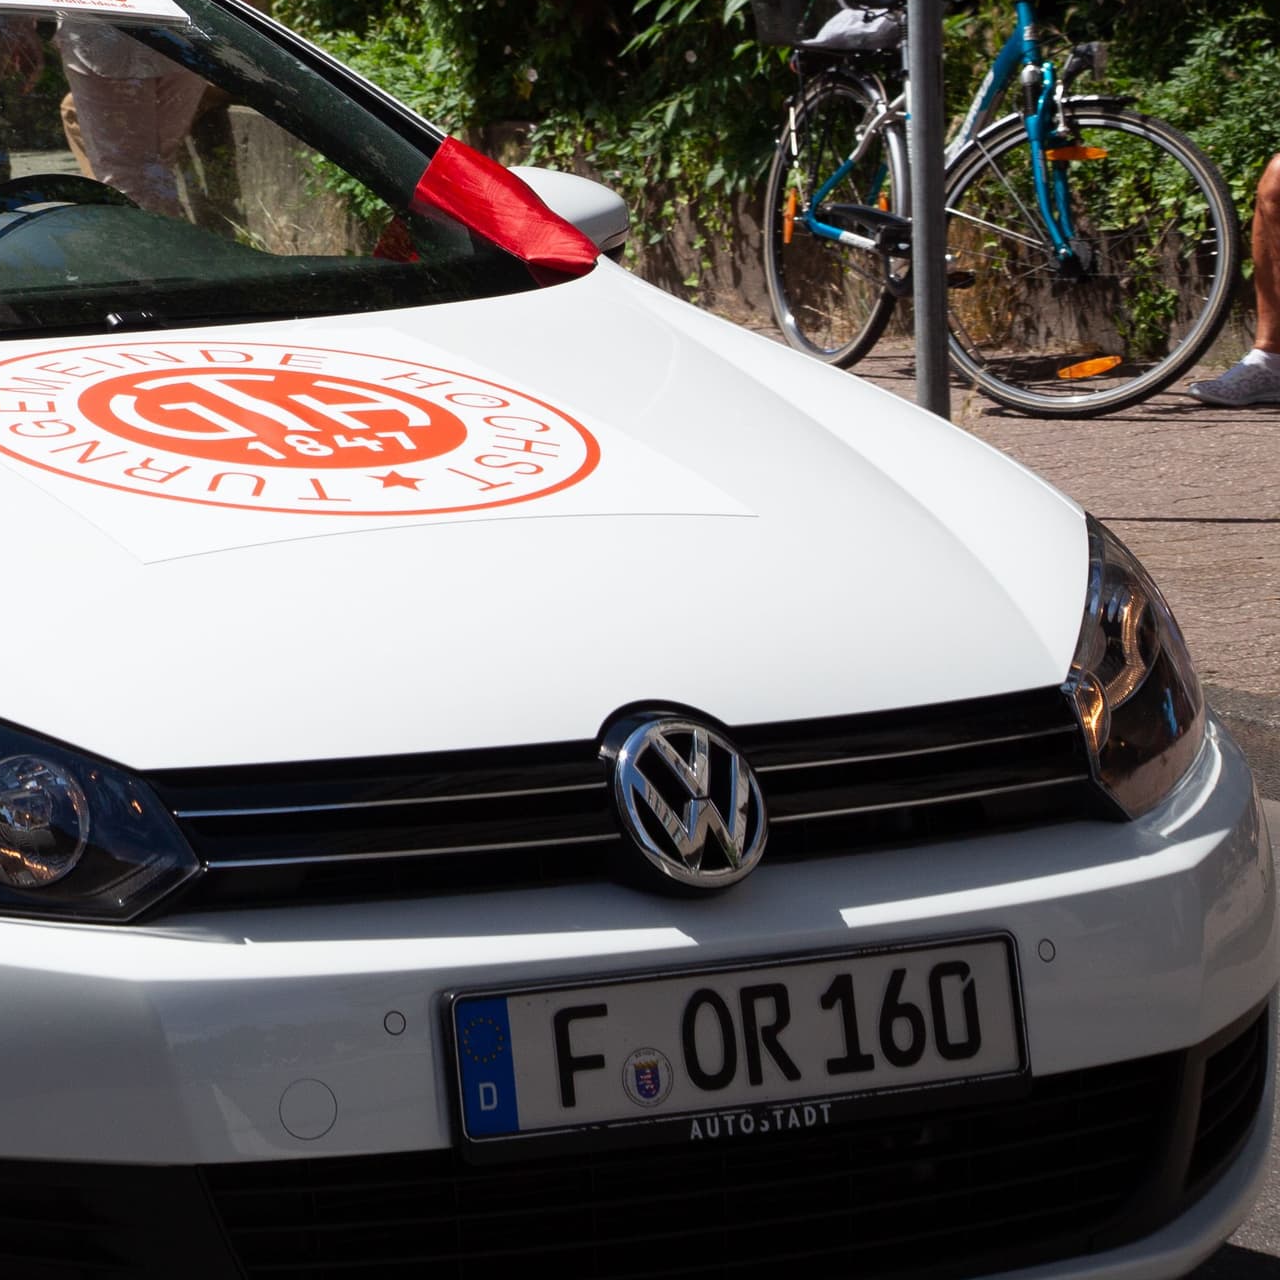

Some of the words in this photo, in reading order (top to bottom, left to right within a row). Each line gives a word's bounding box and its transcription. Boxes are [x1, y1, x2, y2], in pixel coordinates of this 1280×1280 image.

[247, 429, 420, 462] 1847
[381, 370, 561, 494] HÖCHST
[478, 1081, 499, 1112] D
[552, 1003, 609, 1109] F
[681, 982, 803, 1091] OR
[820, 960, 982, 1075] 160
